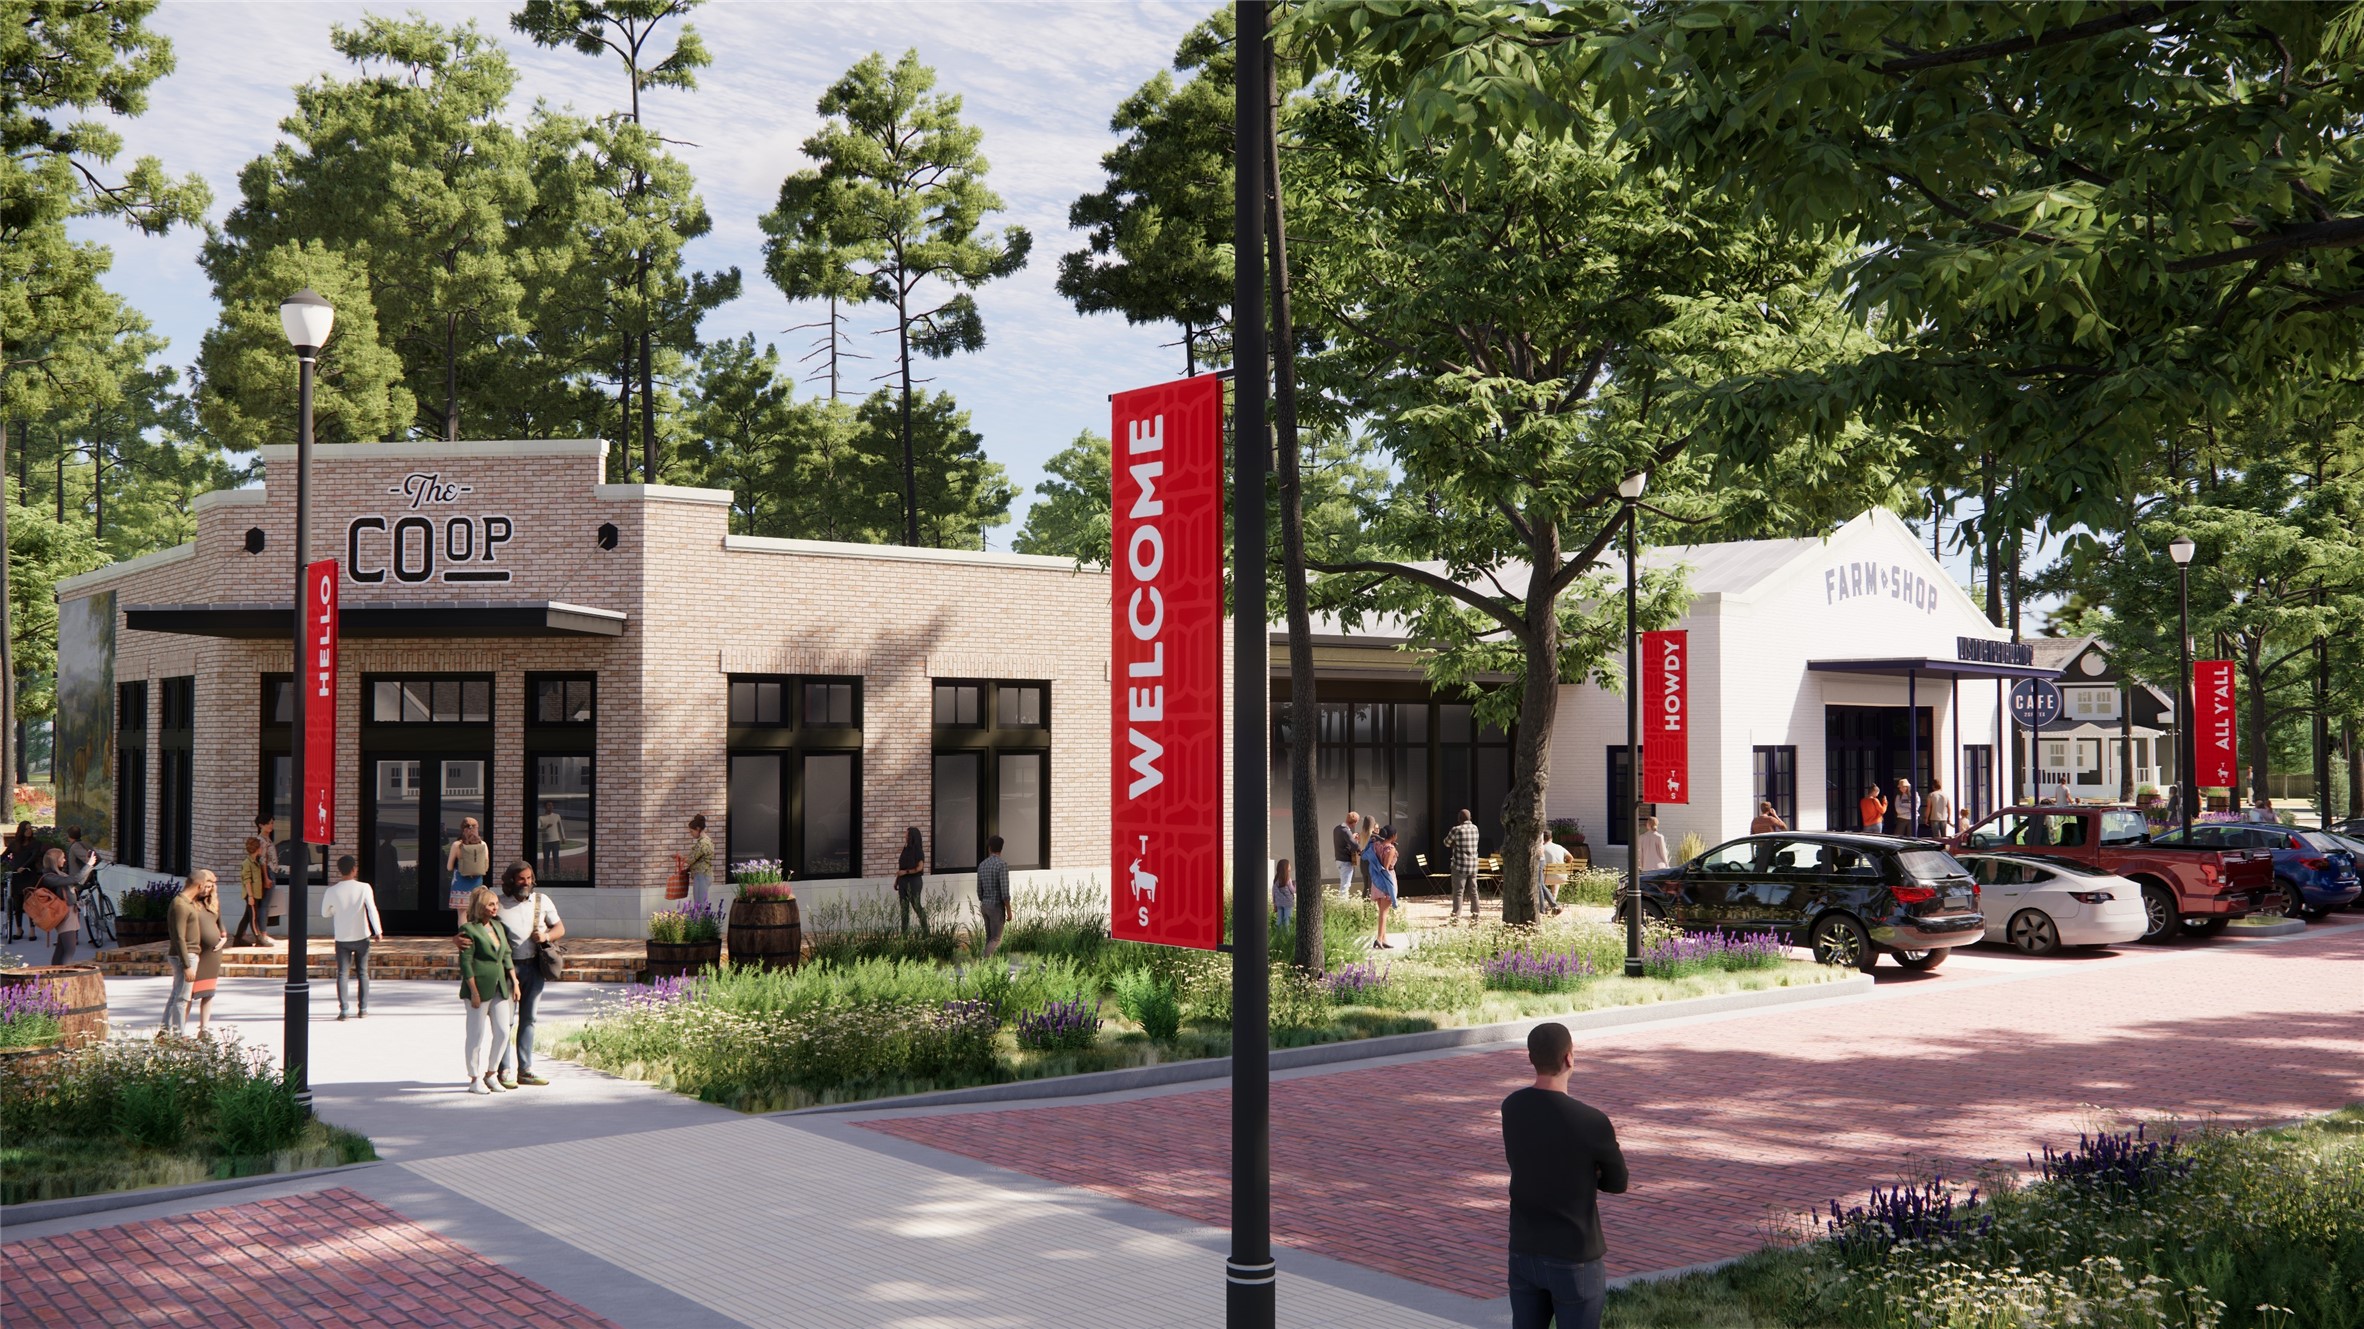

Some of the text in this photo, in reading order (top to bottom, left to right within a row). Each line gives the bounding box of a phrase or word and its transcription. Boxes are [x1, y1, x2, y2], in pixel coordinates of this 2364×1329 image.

[403, 473, 459, 508] The
[348, 516, 512, 583] COOP
[1128, 414, 1164, 801] WELCOME
[1825, 562, 1938, 615] FARM SHOP
[319, 575, 331, 697] HELLO
[1664, 639, 1681, 731] HOWDY
[2015, 694, 2054, 710] CAFE
[2214, 666, 2229, 750] ALL Y'ALL
[1138, 835, 1149, 855] T
[1138, 906, 1149, 927] S
